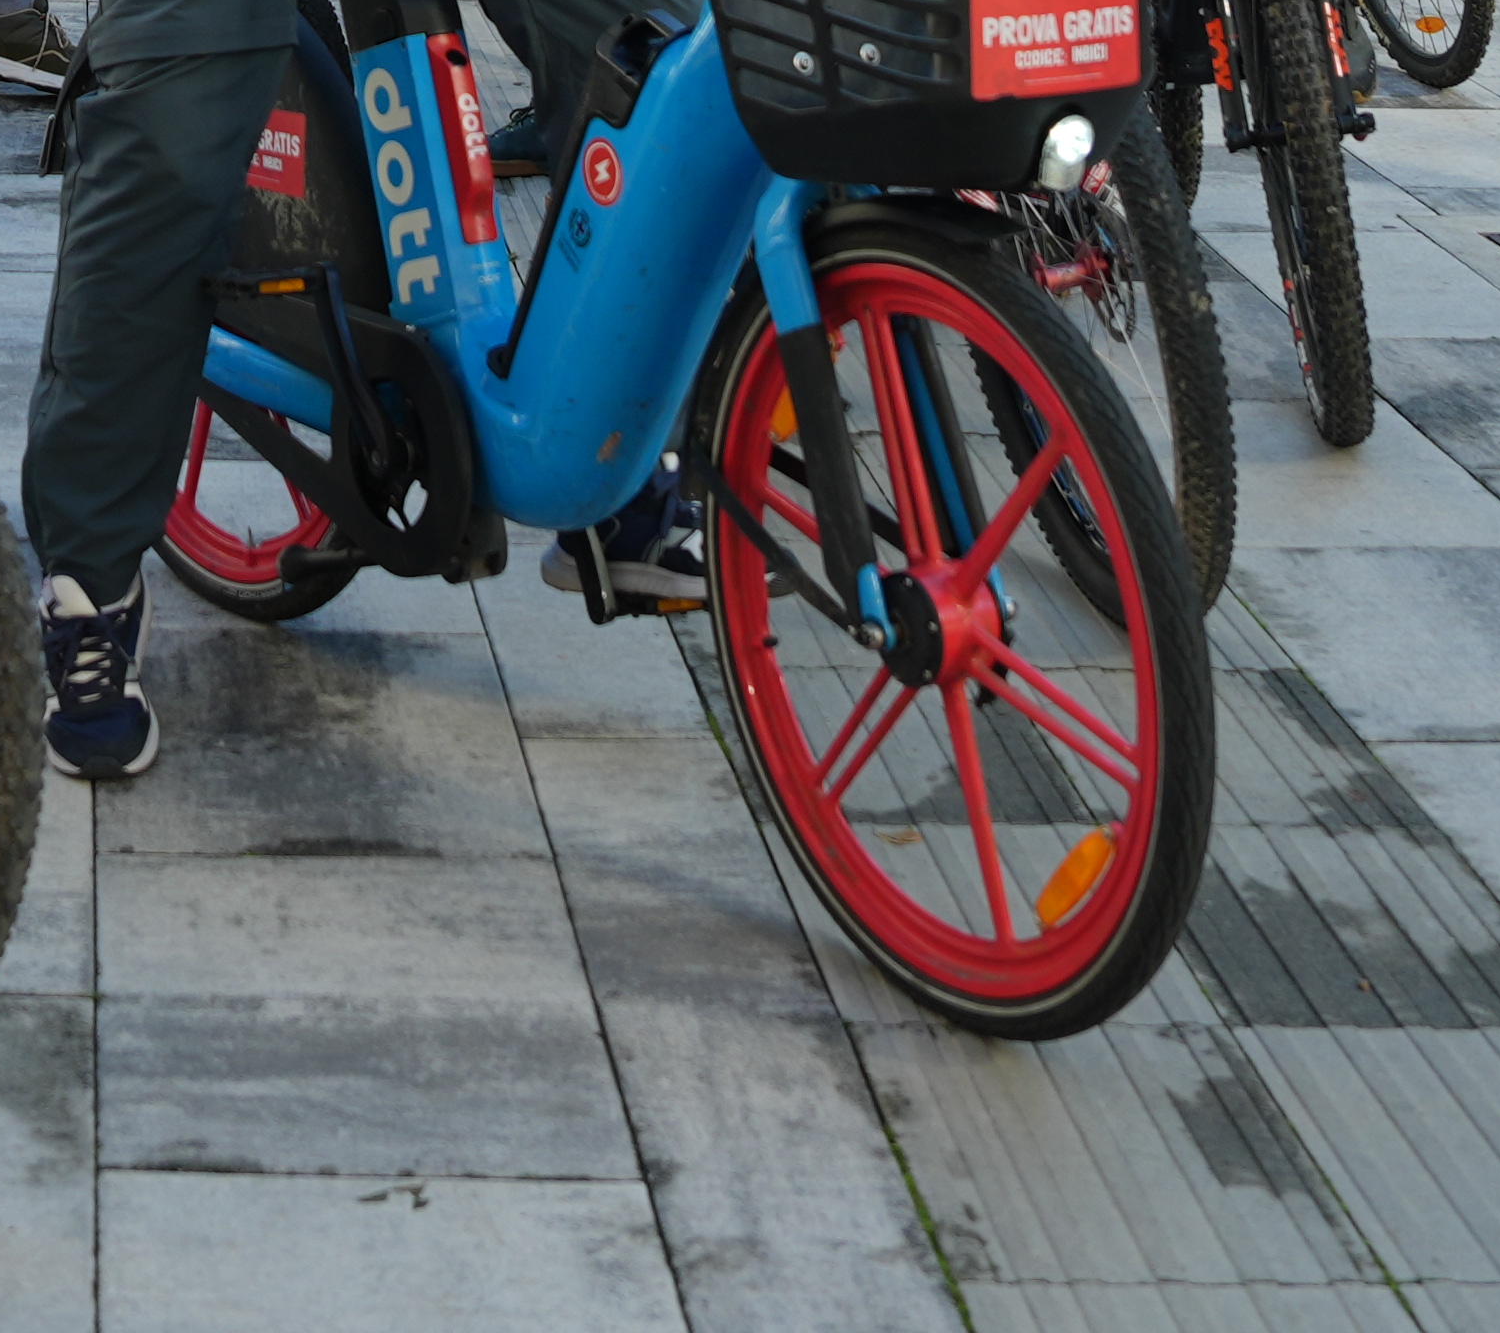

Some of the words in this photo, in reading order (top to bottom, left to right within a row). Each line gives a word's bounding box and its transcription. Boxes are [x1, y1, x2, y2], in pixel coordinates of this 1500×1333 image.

[981, 12, 1060, 49] PROVA
[1063, 5, 1134, 42] GRATIS
[1014, 48, 1067, 71] CODICE:
[458, 92, 487, 159] dott
[363, 67, 442, 306] dott
